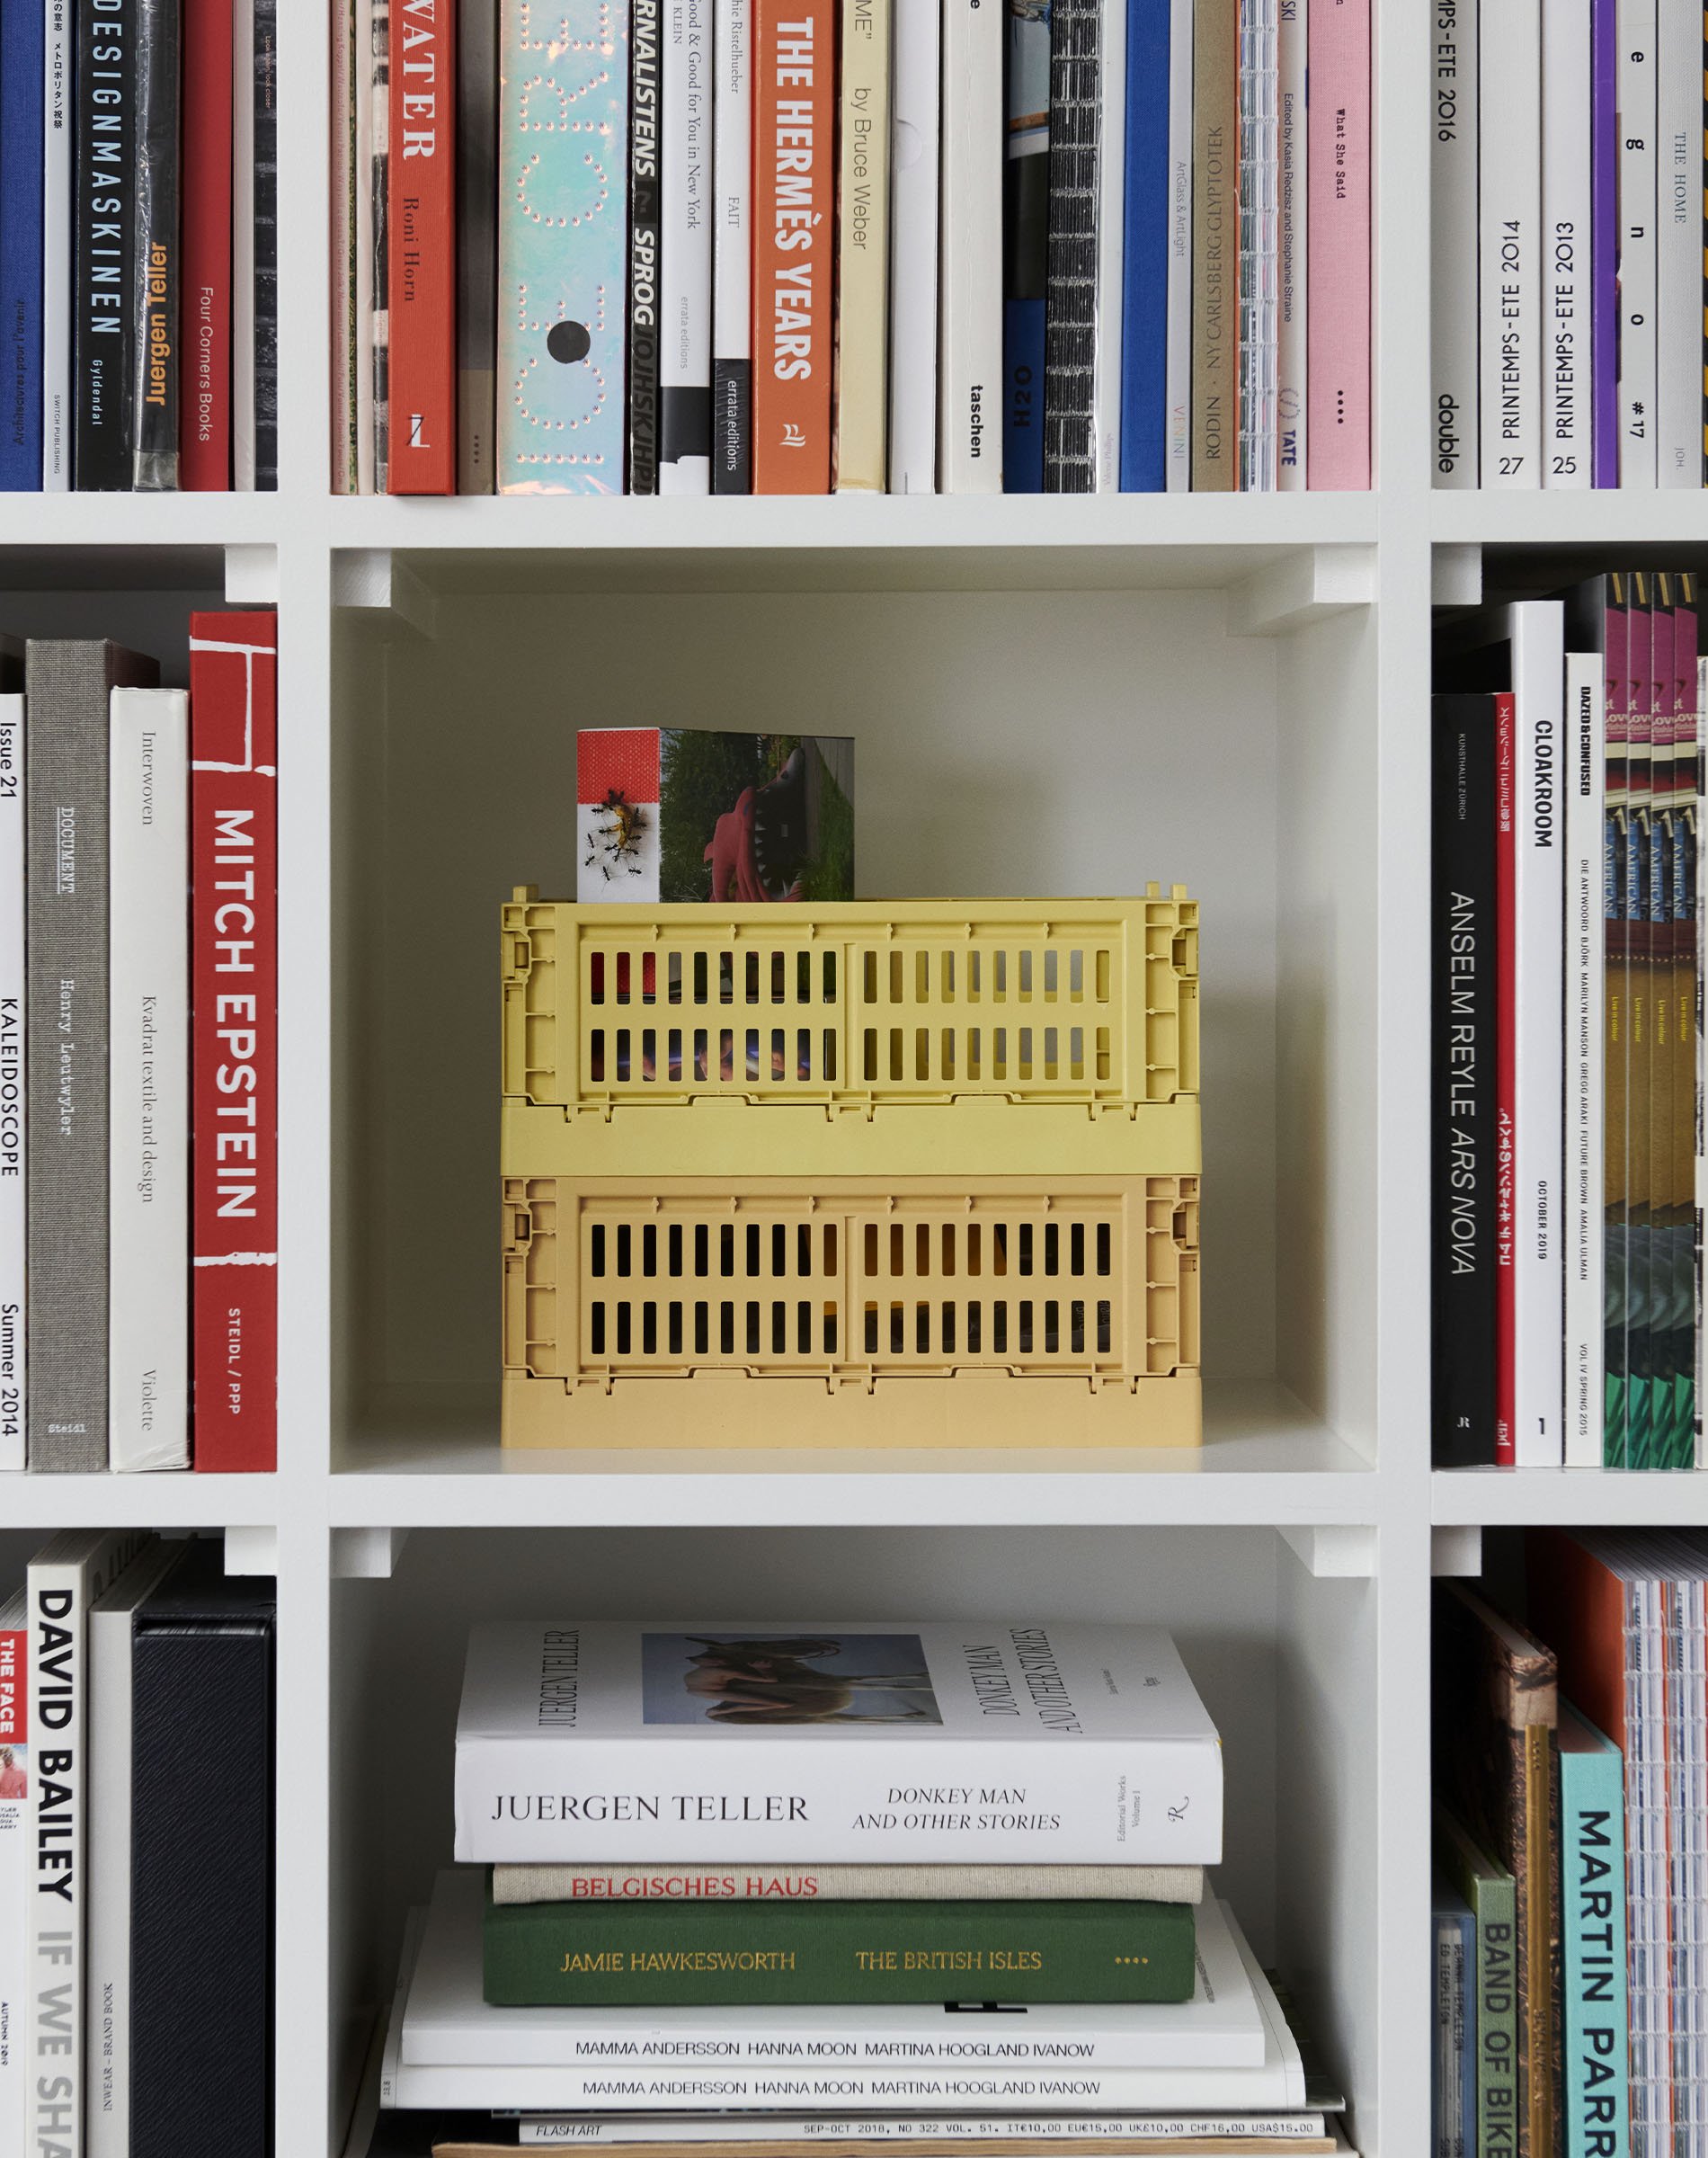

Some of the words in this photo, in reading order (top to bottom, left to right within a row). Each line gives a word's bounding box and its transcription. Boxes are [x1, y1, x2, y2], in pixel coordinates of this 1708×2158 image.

[673, 6, 681, 44] KLEIN
[688, 51, 701, 89] Good
[731, 22, 743, 94] Ristelhueber
[776, 16, 814, 87] THE
[403, 0, 436, 160] WATER
[635, 0, 656, 177] RNALISTENS
[851, 88, 872, 111] by
[688, 116, 701, 143] You
[1284, 93, 1294, 122] Edited
[1336, 108, 1346, 138] What
[1437, 90, 1457, 142] 2016
[92, 0, 122, 334] DESIGNMASKINEN
[853, 119, 872, 178] Bruce
[1336, 144, 1346, 165] She
[1674, 131, 1686, 165] THE
[688, 165, 701, 195] New
[775, 101, 823, 251] HERMÈS
[1206, 126, 1223, 231] GLYPTOTEK
[1336, 171, 1346, 199] Said
[1674, 174, 1686, 224] HOME
[404, 198, 420, 242] Roni
[688, 200, 701, 230] York
[729, 197, 740, 228] FAIT
[852, 184, 871, 250] Weber
[1501, 219, 1520, 272] 2014
[1555, 222, 1574, 272] 2013
[147, 241, 168, 306] Teller
[404, 252, 421, 302] Horn
[633, 227, 655, 325] SPROG
[1206, 236, 1222, 341] CARLSBERG
[200, 287, 214, 322] Four
[774, 263, 812, 380] YEARS
[147, 313, 171, 406] Juergen
[199, 325, 213, 389] Corners
[1206, 346, 1222, 370] NY
[90, 360, 102, 425] Gyldendal
[199, 394, 213, 441] Books
[727, 379, 737, 418] errata
[727, 420, 740, 471] editions
[970, 384, 983, 459] taschen
[1173, 405, 1186, 459] VENINI
[1205, 396, 1221, 459] RODIN
[1437, 394, 1460, 474] double
[1281, 430, 1296, 467] TATE
[1498, 457, 1525, 475] 27
[1552, 456, 1577, 475] 25
[0, 722, 17, 771] Issue
[1458, 733, 1466, 786] KUNSTHALLE
[0, 776, 18, 798] 21
[142, 731, 156, 825] Interwoven
[1535, 720, 1553, 847] CLOAKROOM
[1458, 789, 1467, 820] ZÜRICH
[214, 809, 255, 972] MITCH
[1580, 877, 1589, 932] ANTWOORD
[1450, 891, 1475, 1014] ANSELM
[58, 978, 75, 1033] Henry
[1580, 972, 1589, 1013] MARILYN
[142, 995, 157, 1056] Kvadrat
[1580, 1015, 1589, 1057] MANSON
[1, 998, 19, 1176] KALEIDOSCOPE
[58, 1042, 75, 1136] Leutwyler
[142, 1061, 157, 1111] textile
[1450, 1024, 1475, 1117] REYLE
[1580, 1062, 1589, 1094] GREGG
[142, 1115, 157, 1145] and
[216, 994, 257, 1217] EPSTEIN
[1579, 1096, 1589, 1125] ARAKI
[1450, 1128, 1476, 1190] ARS
[1579, 1130, 1588, 1166] FUTURE
[138, 1150, 157, 1203] design
[1579, 1169, 1588, 1204] BROWN
[1537, 1180, 1548, 1228] OCTOBER
[1579, 1209, 1588, 1245] AMALIA
[1450, 1195, 1476, 1275] NOVA
[1537, 1233, 1548, 1260] 2019
[1, 1304, 19, 1380] Summer
[228, 1308, 241, 1363] STEIDL
[1, 1389, 19, 1437] 2014
[141, 1369, 157, 1431] Violette
[228, 1383, 241, 1414] PPP
[0, 1638, 14, 1678] THE
[39, 1589, 73, 1730] DAVID
[0, 1682, 14, 1734] FACE
[491, 1795, 661, 1822] JUERGEN
[672, 1795, 809, 1822] TELLER
[886, 1788, 975, 1805] DONKEY
[977, 1788, 1027, 1805] MAN
[38, 1750, 73, 1903] BAILEY
[852, 1813, 897, 1831] AND
[903, 1813, 972, 1831] OTHER
[976, 1813, 1062, 1831] STORIES
[572, 1877, 736, 1897] BELGISCHES
[745, 1877, 819, 1897] HAUS
[1578, 1810, 1615, 2002] MARTIN
[37, 1931, 73, 1966] IF
[559, 1952, 625, 1972] JAMIE
[630, 1951, 796, 1972] HAWKESWORTH
[855, 1951, 898, 1970] THE
[903, 1951, 983, 1970] BRITISH
[988, 1951, 1043, 1970] ISLES
[1484, 1922, 1511, 2015] BAND
[1, 2002, 9, 2040] AUTUMN
[37, 1983, 73, 2056] WE
[103, 1982, 113, 2014] BOOK
[103, 2017, 113, 2056] BRAND
[575, 2041, 638, 2055] MAMMA
[642, 2041, 740, 2055] ANDERSSON
[747, 2041, 803, 2056] HANNA
[807, 2042, 857, 2056] MOON
[865, 2042, 935, 2056] MARTINA
[939, 2042, 1029, 2057] HOOGLAND
[1033, 2043, 1095, 2057] IVANOW
[1484, 2030, 1511, 2074] OF
[103, 2065, 113, 2111] INWEAR
[583, 2081, 646, 2095] MAMMA
[649, 2081, 747, 2095] ANDERSSON
[755, 2081, 810, 2095] HANNA
[814, 2081, 864, 2095] MOON
[871, 2081, 941, 2095] MARTINA
[946, 2081, 1036, 2095] HOOGLAND
[1039, 2081, 1101, 2095] IVANOW
[1582, 2028, 1616, 2158] PARR
[536, 2124, 576, 2137] FLASH
[578, 2124, 602, 2137] ART
[804, 2124, 851, 2134] SEP-OCT
[858, 2124, 891, 2135] 2018,
[1485, 2087, 1513, 2158] BIKE
